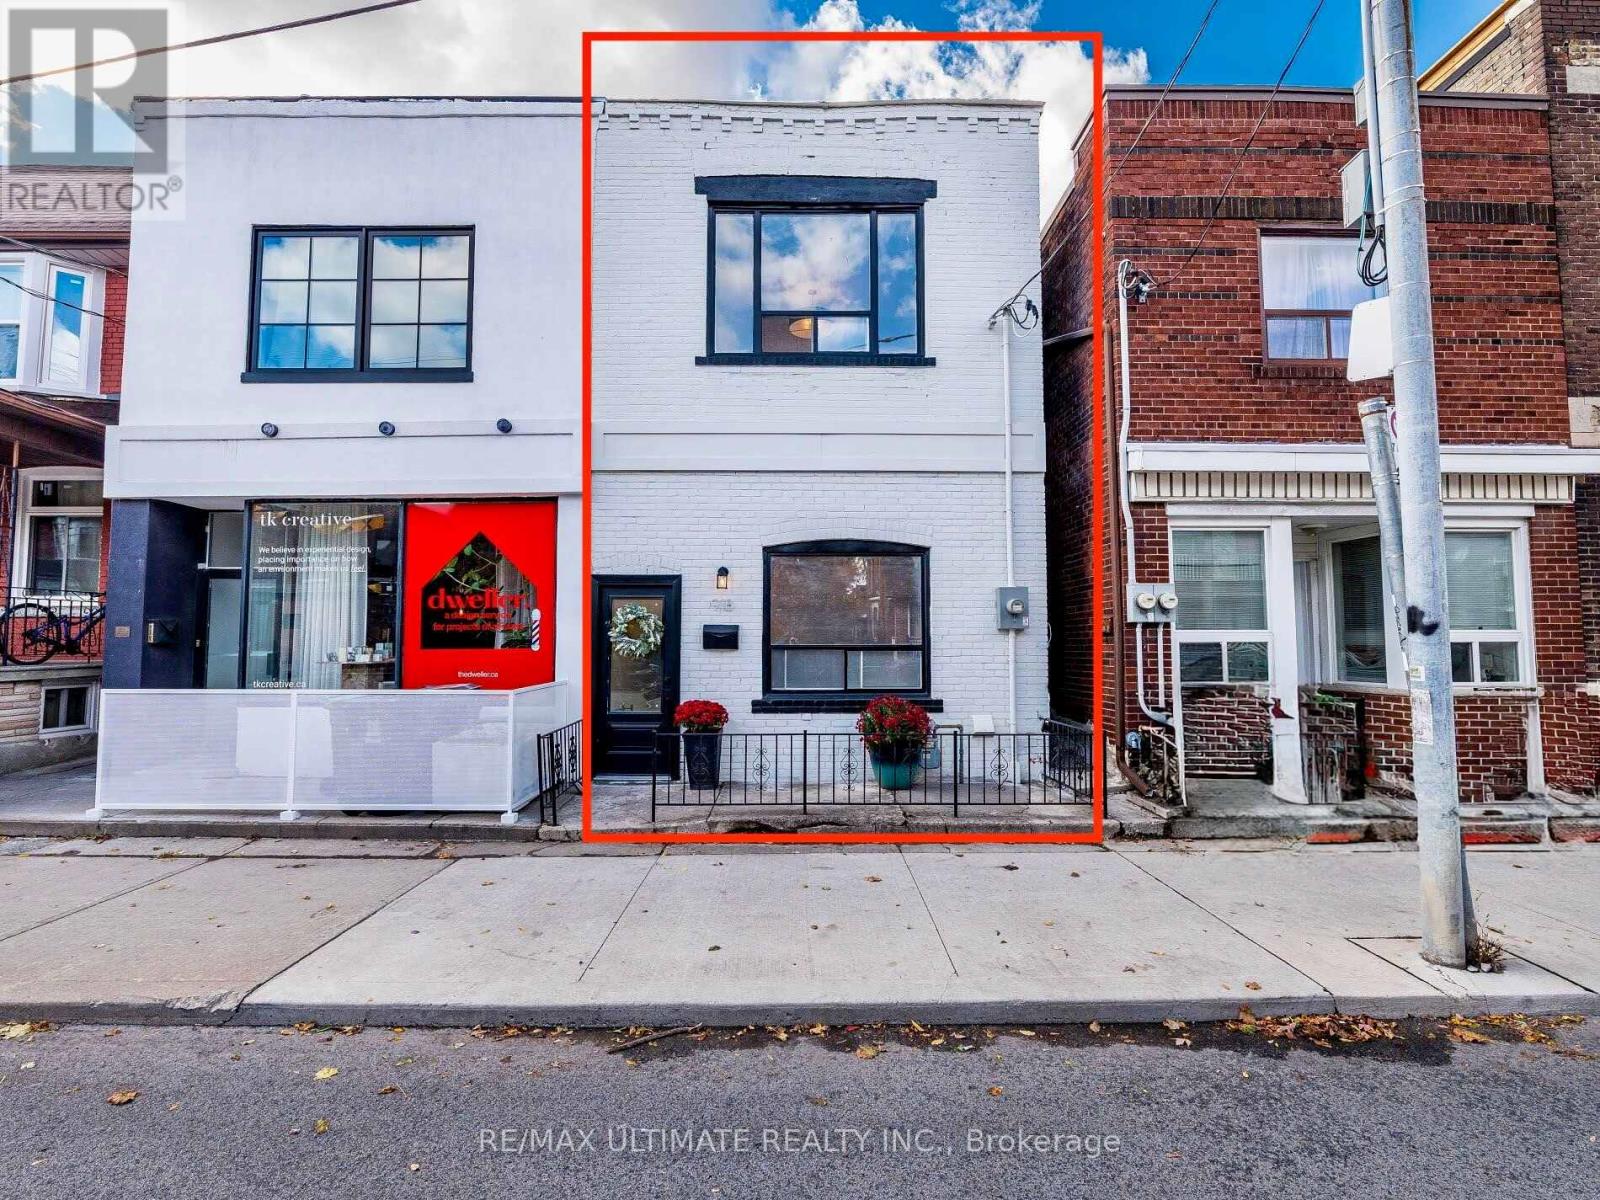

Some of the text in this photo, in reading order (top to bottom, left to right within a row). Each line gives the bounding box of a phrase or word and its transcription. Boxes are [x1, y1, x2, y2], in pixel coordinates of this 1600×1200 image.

[260, 511, 352, 527] tk creative
[258, 546, 270, 554] We
[271, 546, 295, 554] believe
[296, 546, 304, 554] in
[257, 556, 285, 565] placing
[433, 622, 444, 631] for
[446, 622, 481, 633] projects
[252, 680, 306, 689] tkcreative.ca
